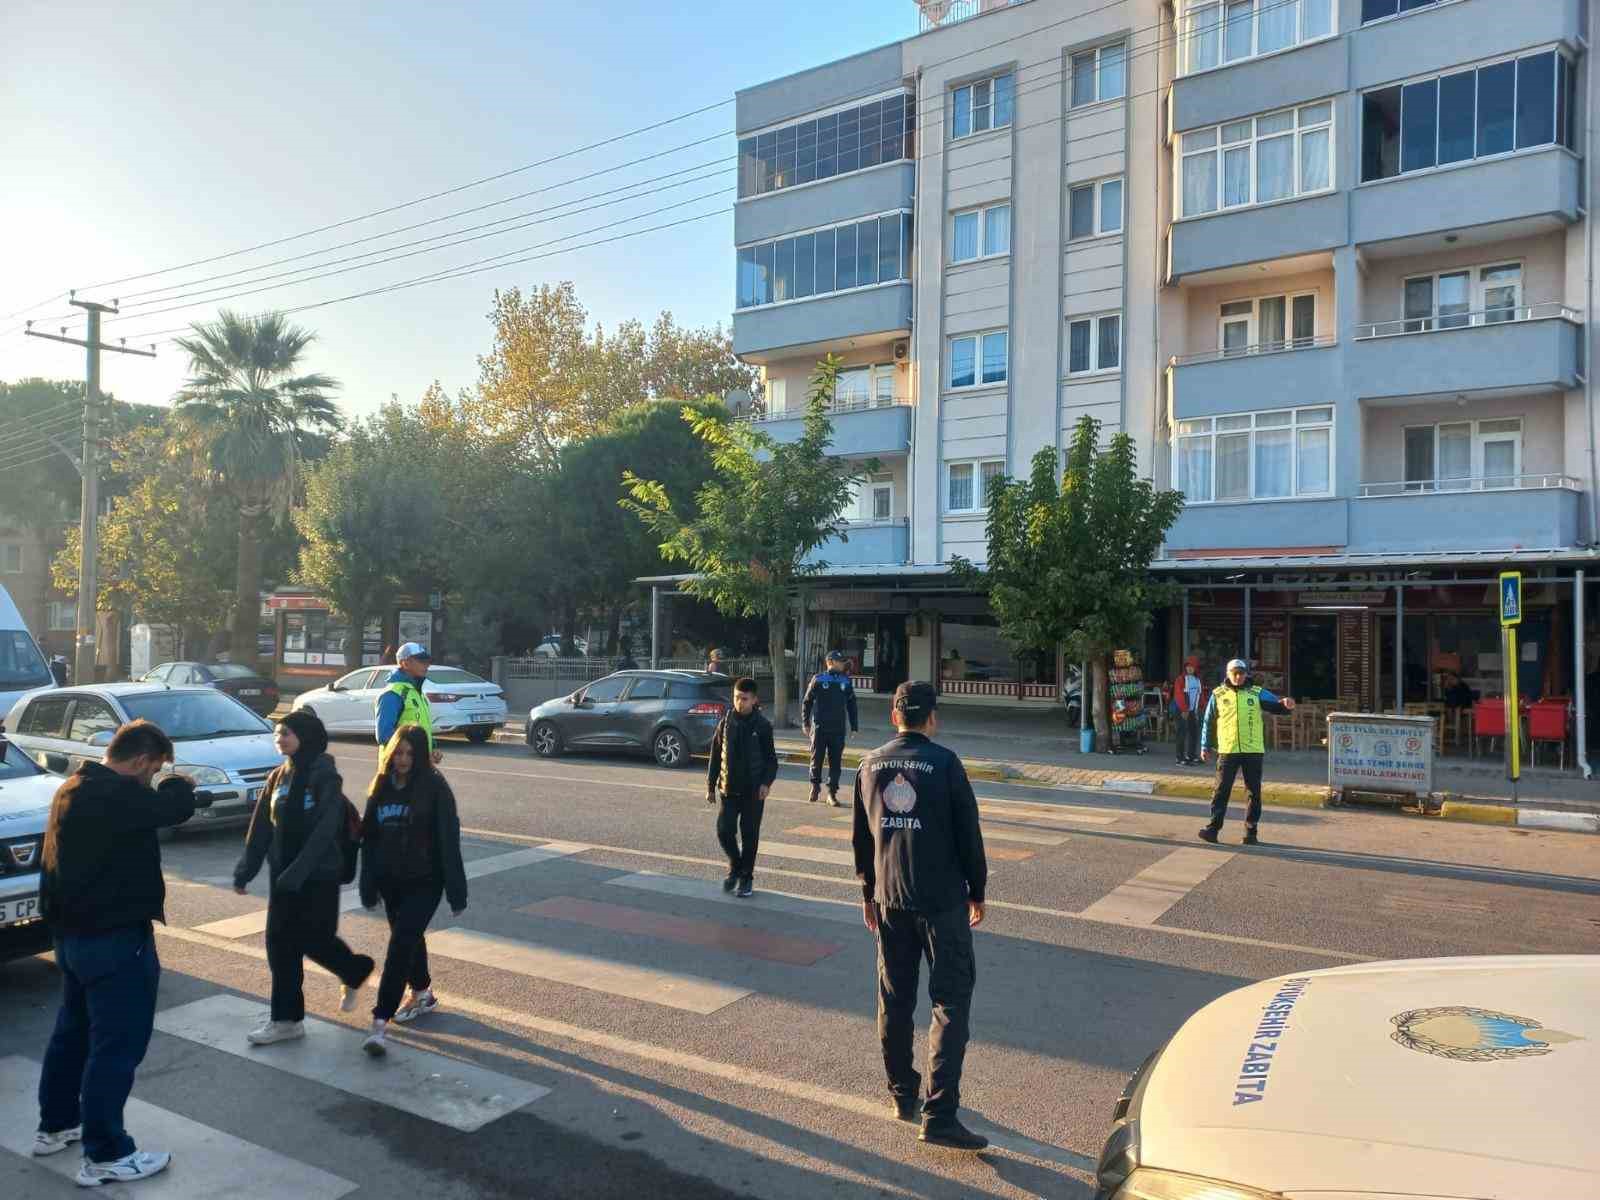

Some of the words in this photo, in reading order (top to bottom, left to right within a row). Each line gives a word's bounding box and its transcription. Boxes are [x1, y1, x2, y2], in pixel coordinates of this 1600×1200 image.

[881, 816, 922, 829] ZABITA
[1254, 977, 1312, 1039] BÜYÜKŞEHİR
[1232, 1042, 1277, 1105] ZABITA
